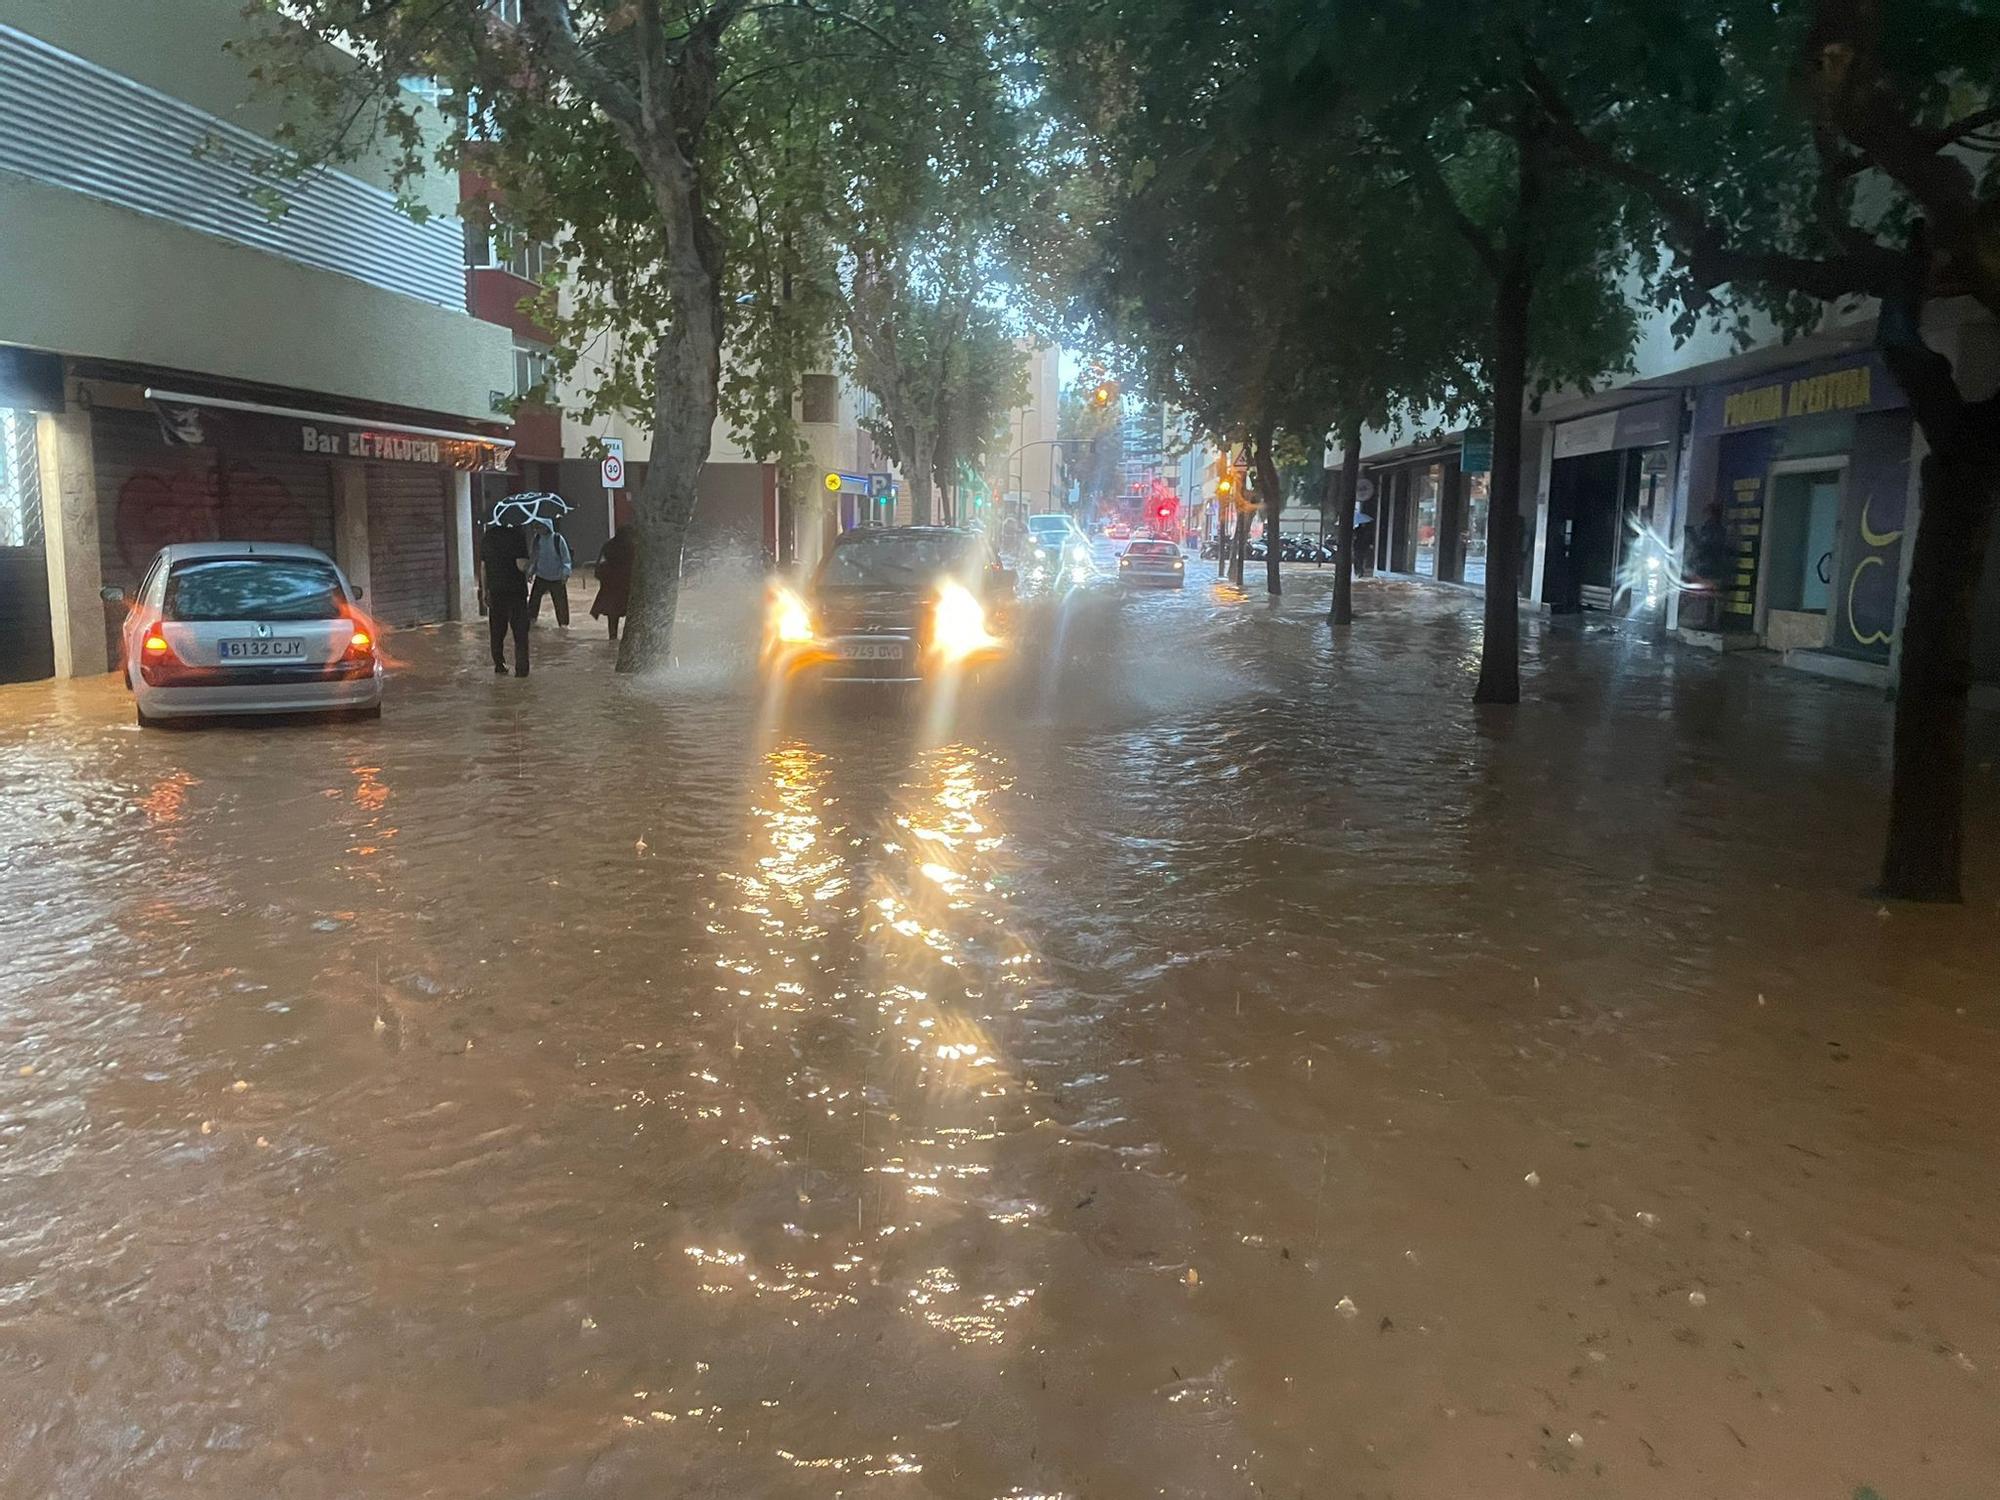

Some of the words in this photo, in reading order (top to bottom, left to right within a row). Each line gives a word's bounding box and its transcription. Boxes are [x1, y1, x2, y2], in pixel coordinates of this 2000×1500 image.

[1786, 366, 1870, 417] APERTURA
[302, 426, 340, 453] Bar
[348, 432, 370, 457] EL
[607, 464, 618, 473] 30
[871, 475, 887, 495] P
[231, 643, 268, 655] 6132
[273, 642, 300, 654] CJY
